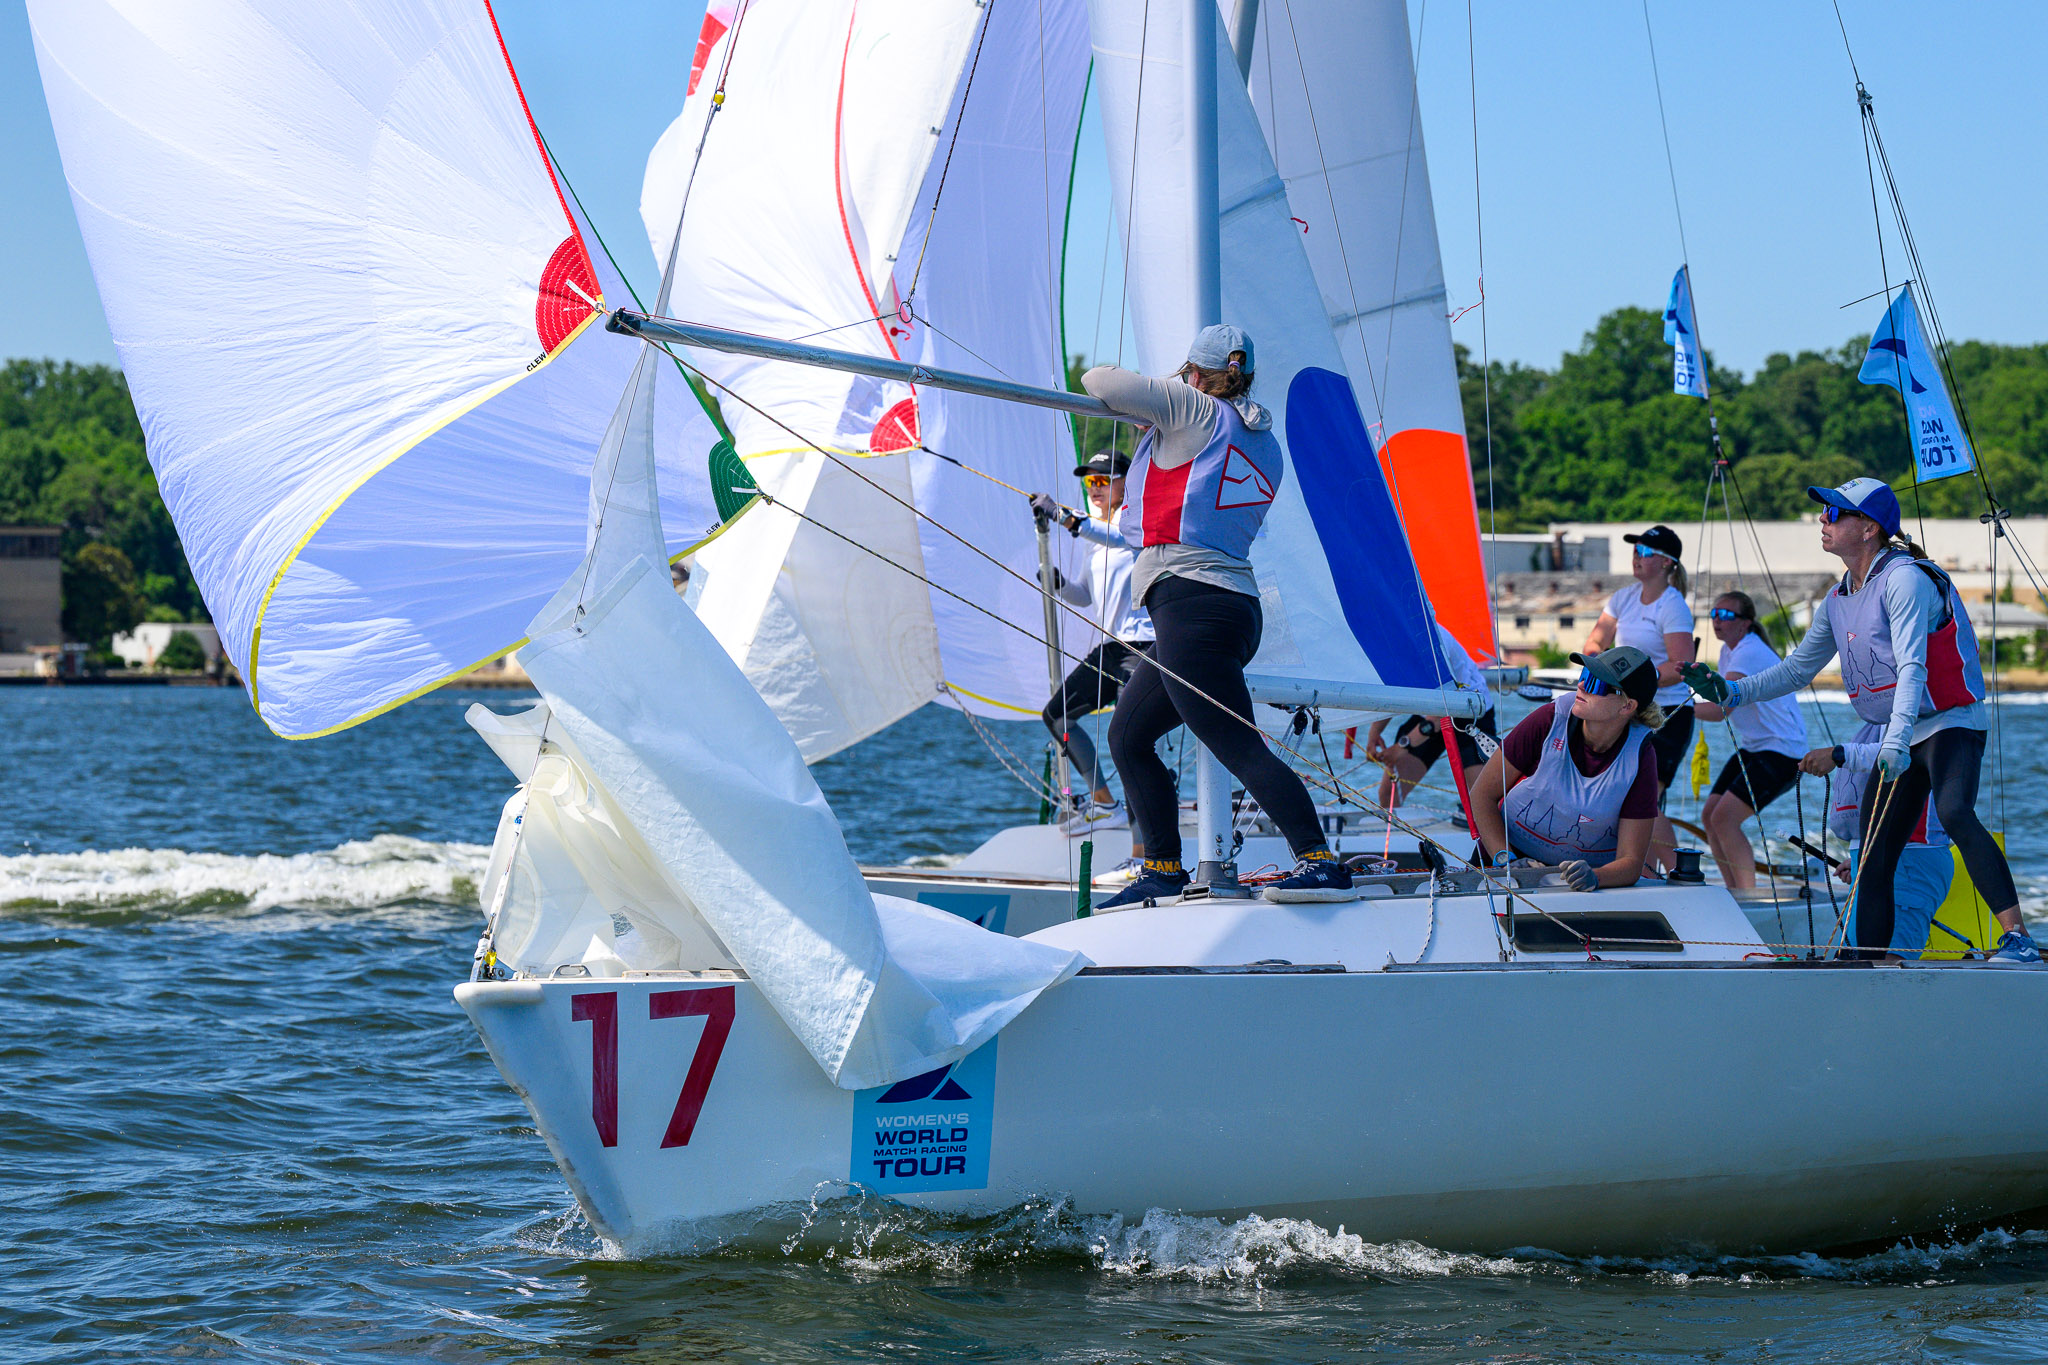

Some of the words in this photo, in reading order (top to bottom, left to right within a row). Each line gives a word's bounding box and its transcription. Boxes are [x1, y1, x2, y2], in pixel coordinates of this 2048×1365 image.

[526, 351, 547, 372] CLEW
[706, 521, 721, 535] CLEW
[571, 986, 736, 1150] 17
[876, 1113, 969, 1127] WOMEN'S
[875, 1128, 968, 1146] WORLD
[873, 1147, 917, 1157] MATCH
[921, 1145, 967, 1154] RACING
[873, 1156, 966, 1178] TOUR
